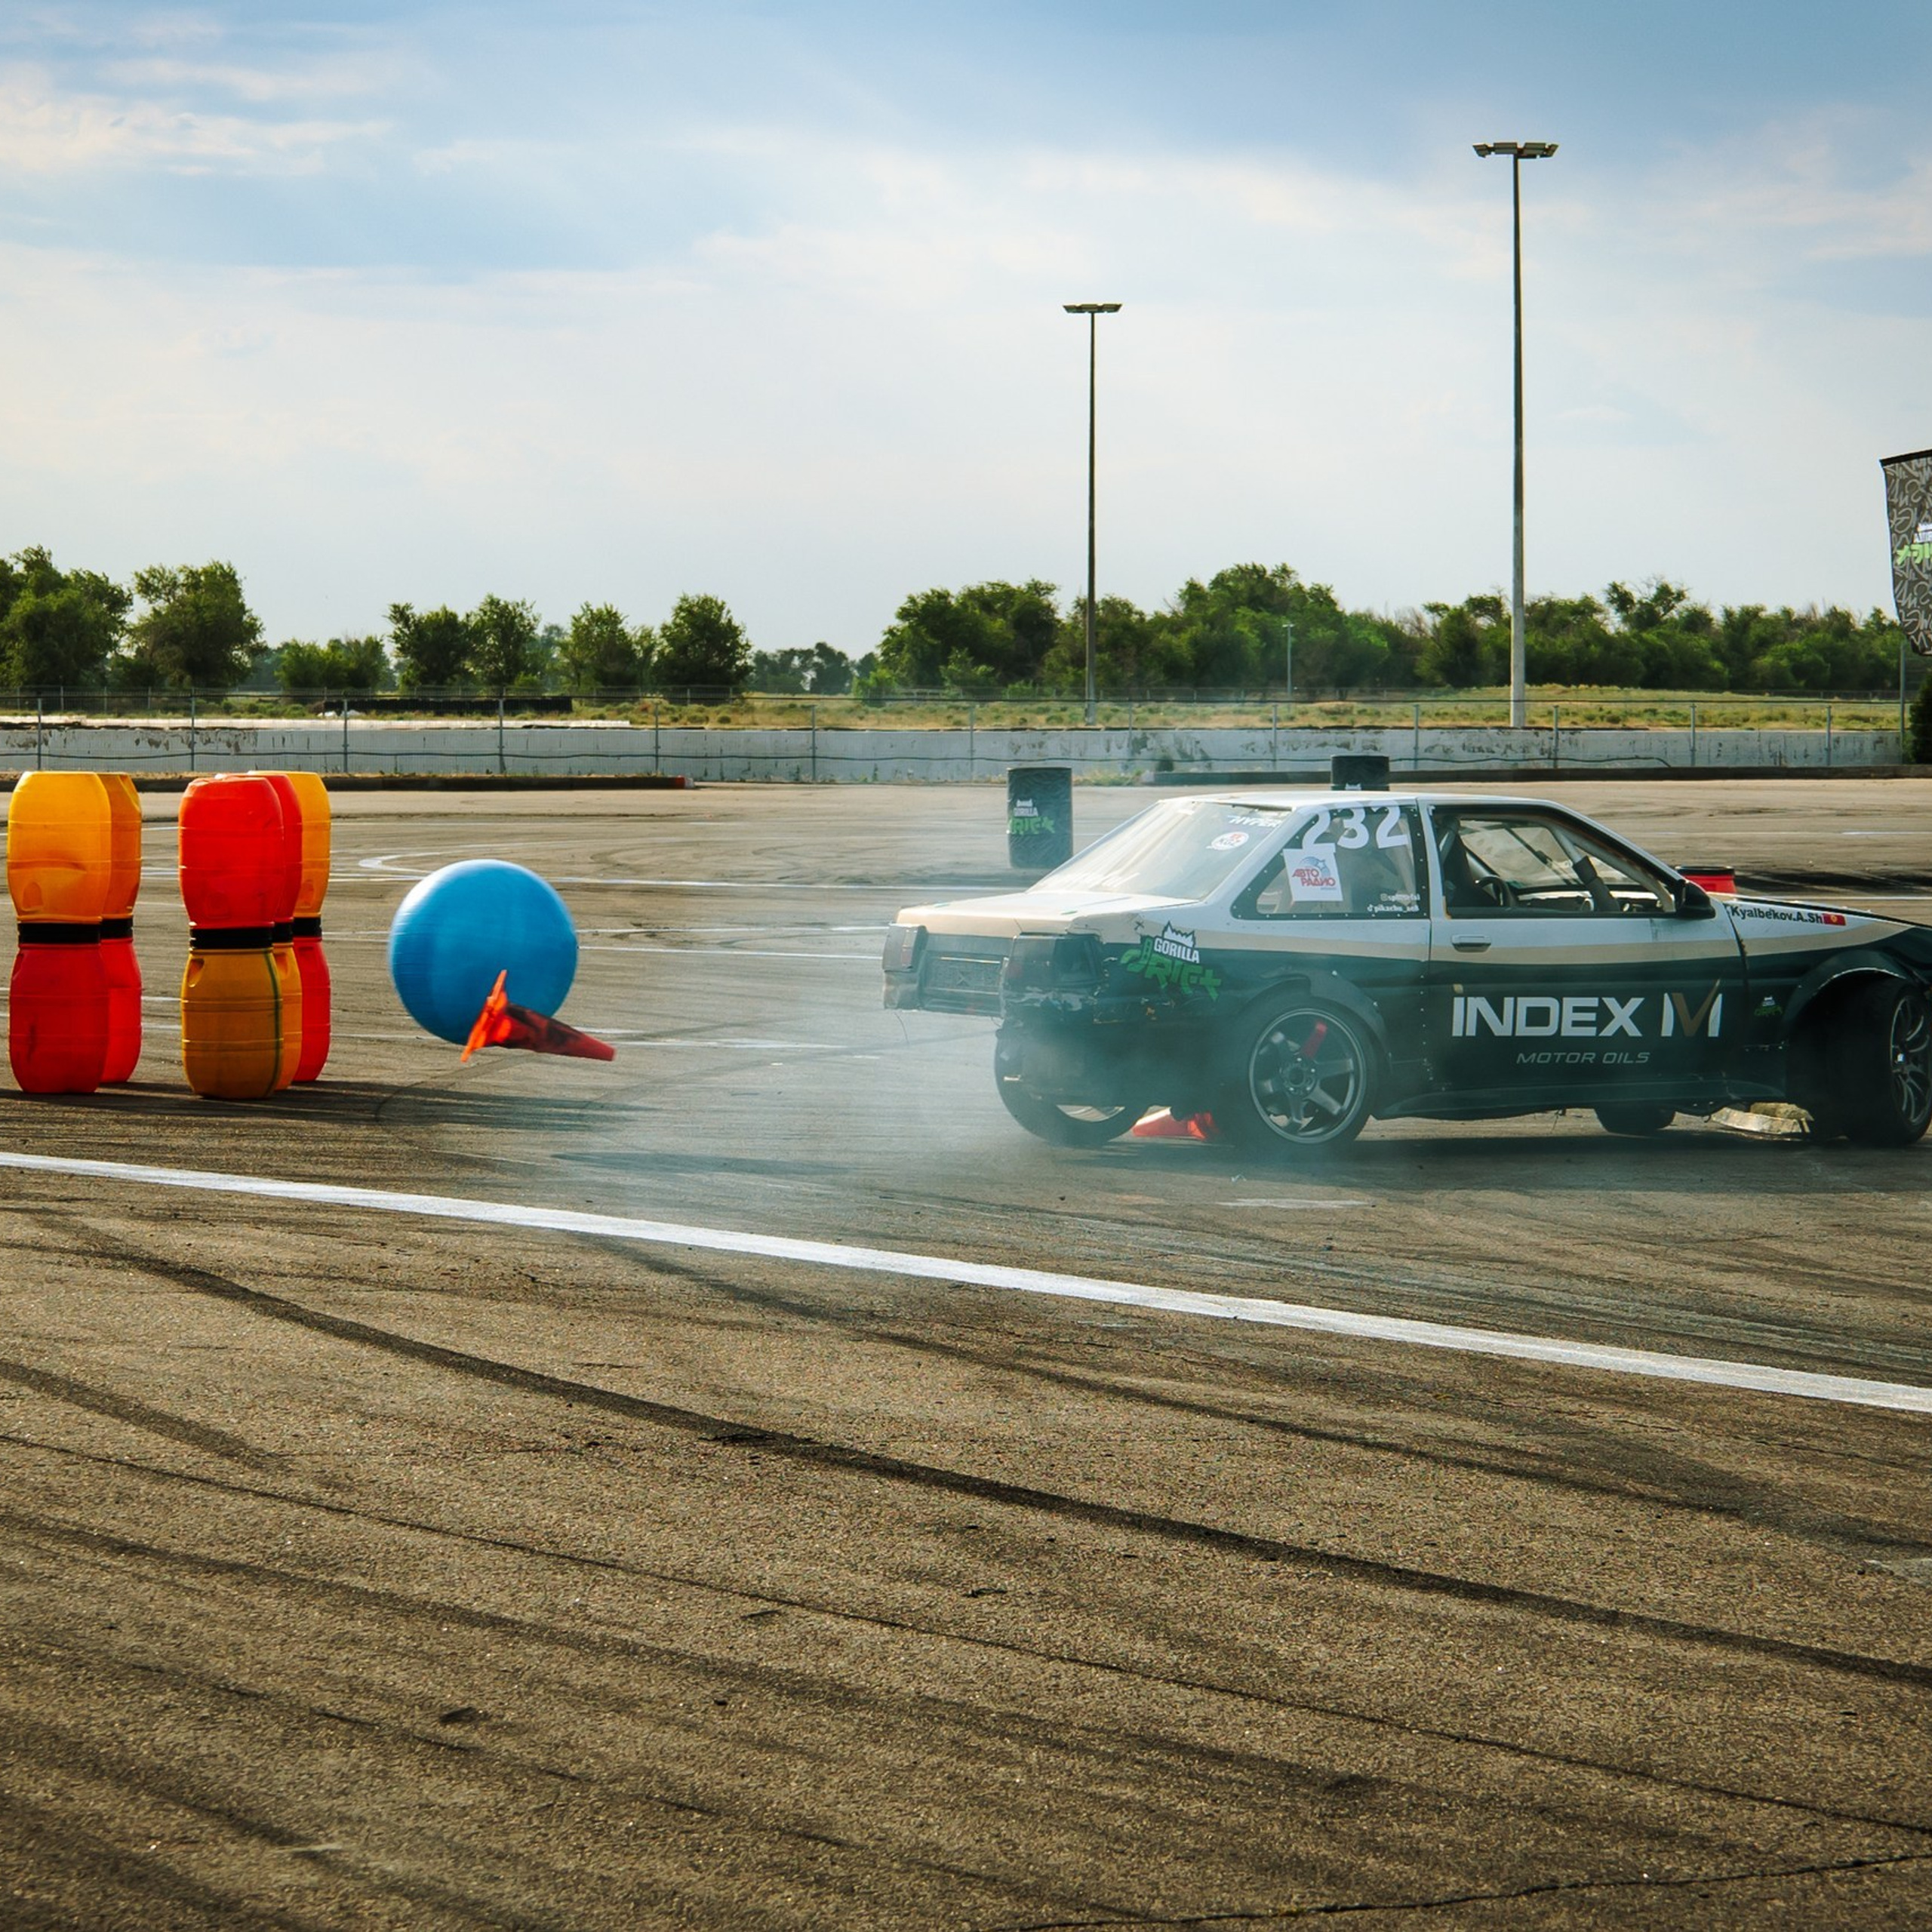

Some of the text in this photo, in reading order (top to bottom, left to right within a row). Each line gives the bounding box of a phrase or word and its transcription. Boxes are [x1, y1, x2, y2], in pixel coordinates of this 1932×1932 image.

[1297, 800, 1409, 850] 232
[1291, 868, 1319, 878] АВТО
[1300, 878, 1336, 887] РАДИО
[1731, 906, 1823, 923] Kyalbekov.A.Sh
[1154, 937, 1200, 964] GORILLA
[1451, 984, 1645, 1037] INDEX
[1516, 1051, 1651, 1064] MOTOR OILS
